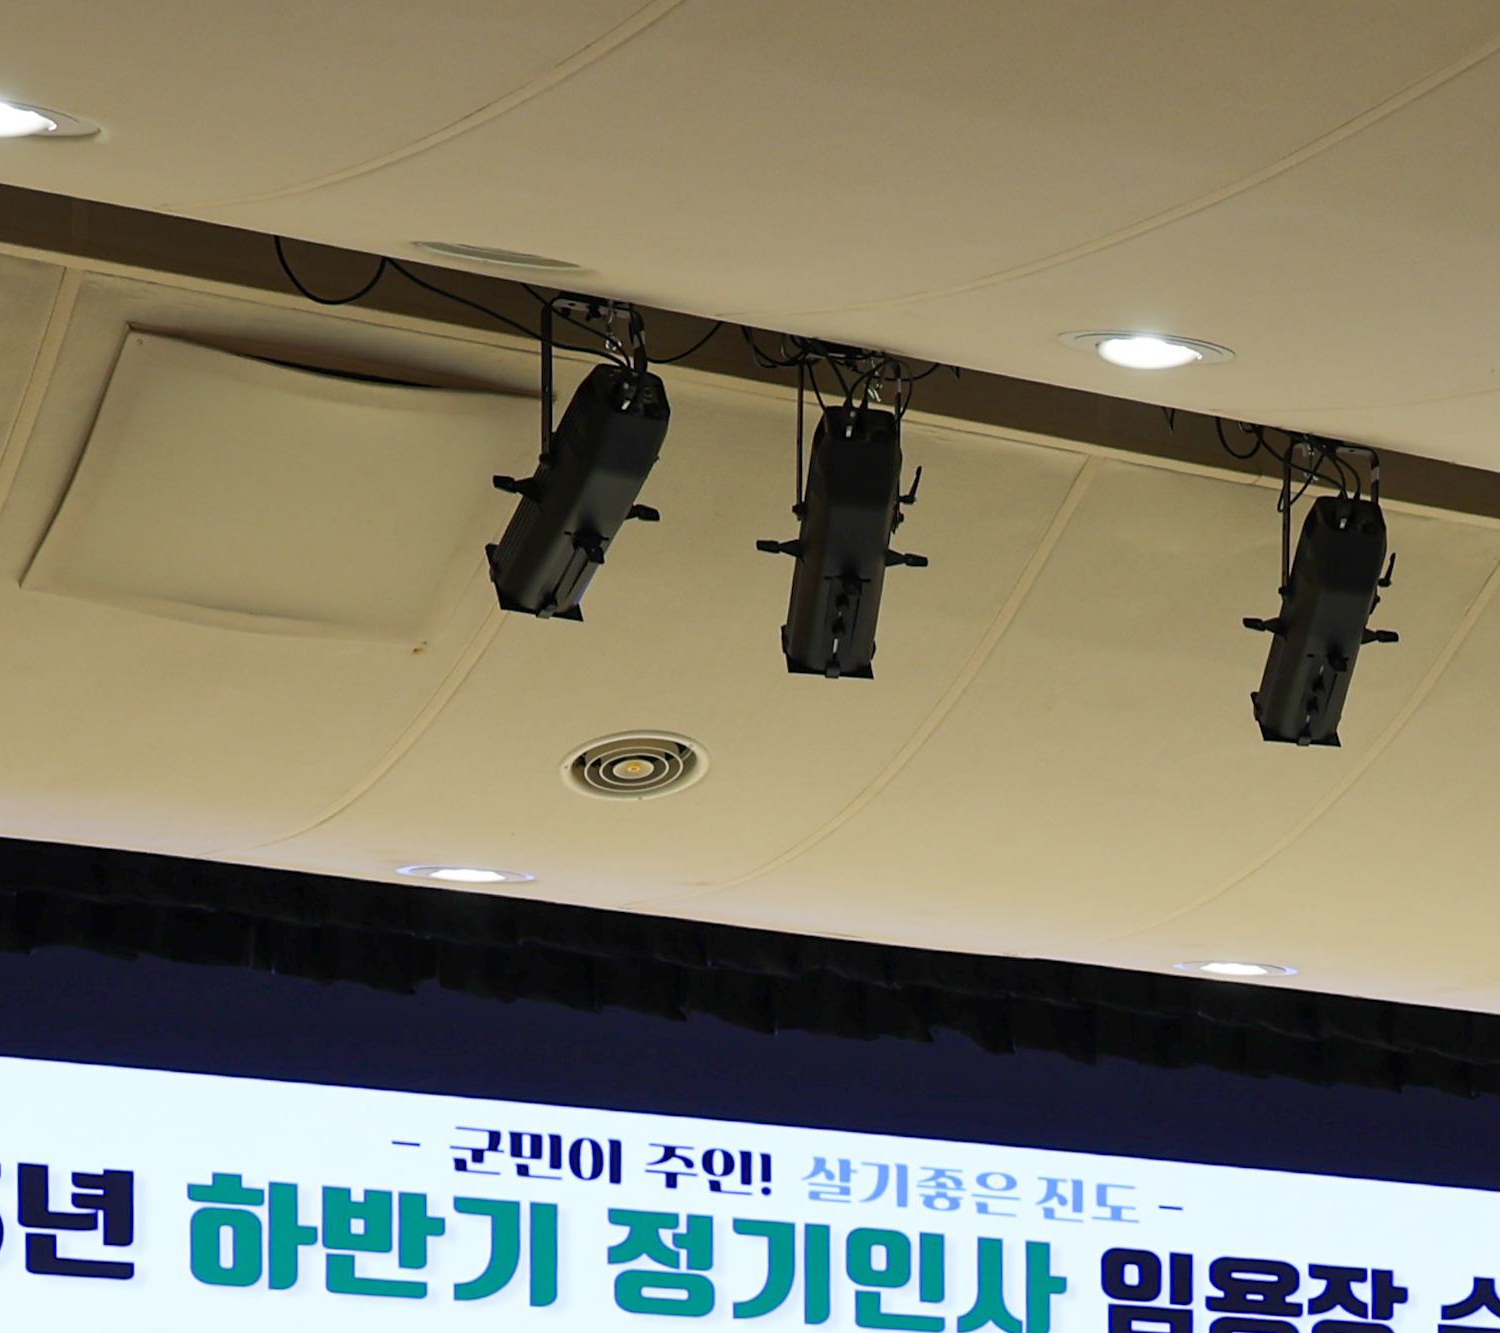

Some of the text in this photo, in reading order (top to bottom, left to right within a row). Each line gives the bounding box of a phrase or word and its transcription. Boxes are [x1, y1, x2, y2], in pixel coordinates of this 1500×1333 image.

[450, 1126, 622, 1184] 군민이
[645, 1142, 772, 1196] 주인!
[801, 1156, 1021, 1217] 살기좋은
[1035, 1176, 1141, 1223] 진도
[187, 1172, 558, 1307] 하반기
